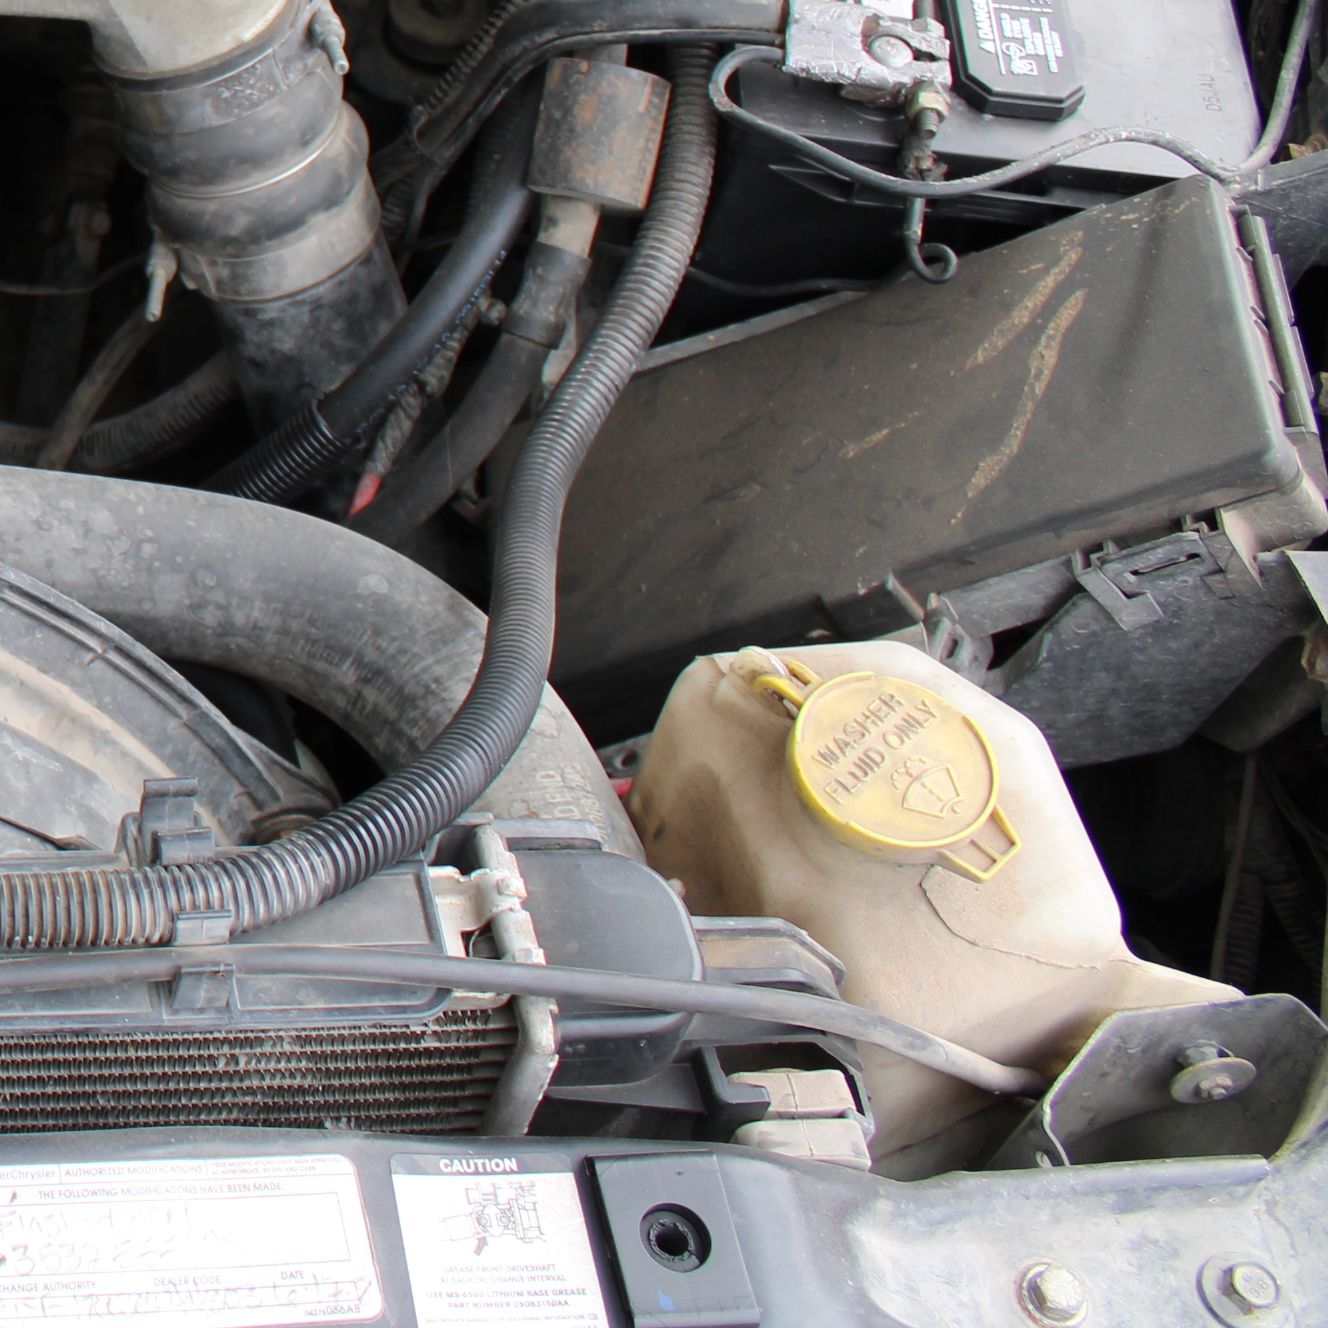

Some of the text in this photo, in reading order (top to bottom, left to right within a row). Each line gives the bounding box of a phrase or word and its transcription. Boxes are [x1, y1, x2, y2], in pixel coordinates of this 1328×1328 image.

[812, 690, 906, 771] WASHER
[823, 699, 939, 806] FLUID ONLY
[64, 1166, 123, 1177] AUTHORIZED
[127, 1164, 203, 1175] MODIFICATIONS
[439, 1157, 519, 1173] CAUTION
[39, 1190, 56, 1200] THE
[58, 1188, 118, 1199] FOLLOWING
[121, 1184, 197, 1196] MODIFICATIONS
[200, 1183, 225, 1194] HAVE
[227, 1182, 251, 1193] BEEN
[506, 1263, 556, 1272] DRIVESHAFT
[280, 1270, 305, 1281] DATE
[42, 1280, 96, 1292] AUTHORITY
[153, 1276, 189, 1288] DEALER
[527, 1289, 550, 1297] BASE
[552, 1287, 587, 1296] GREASE
